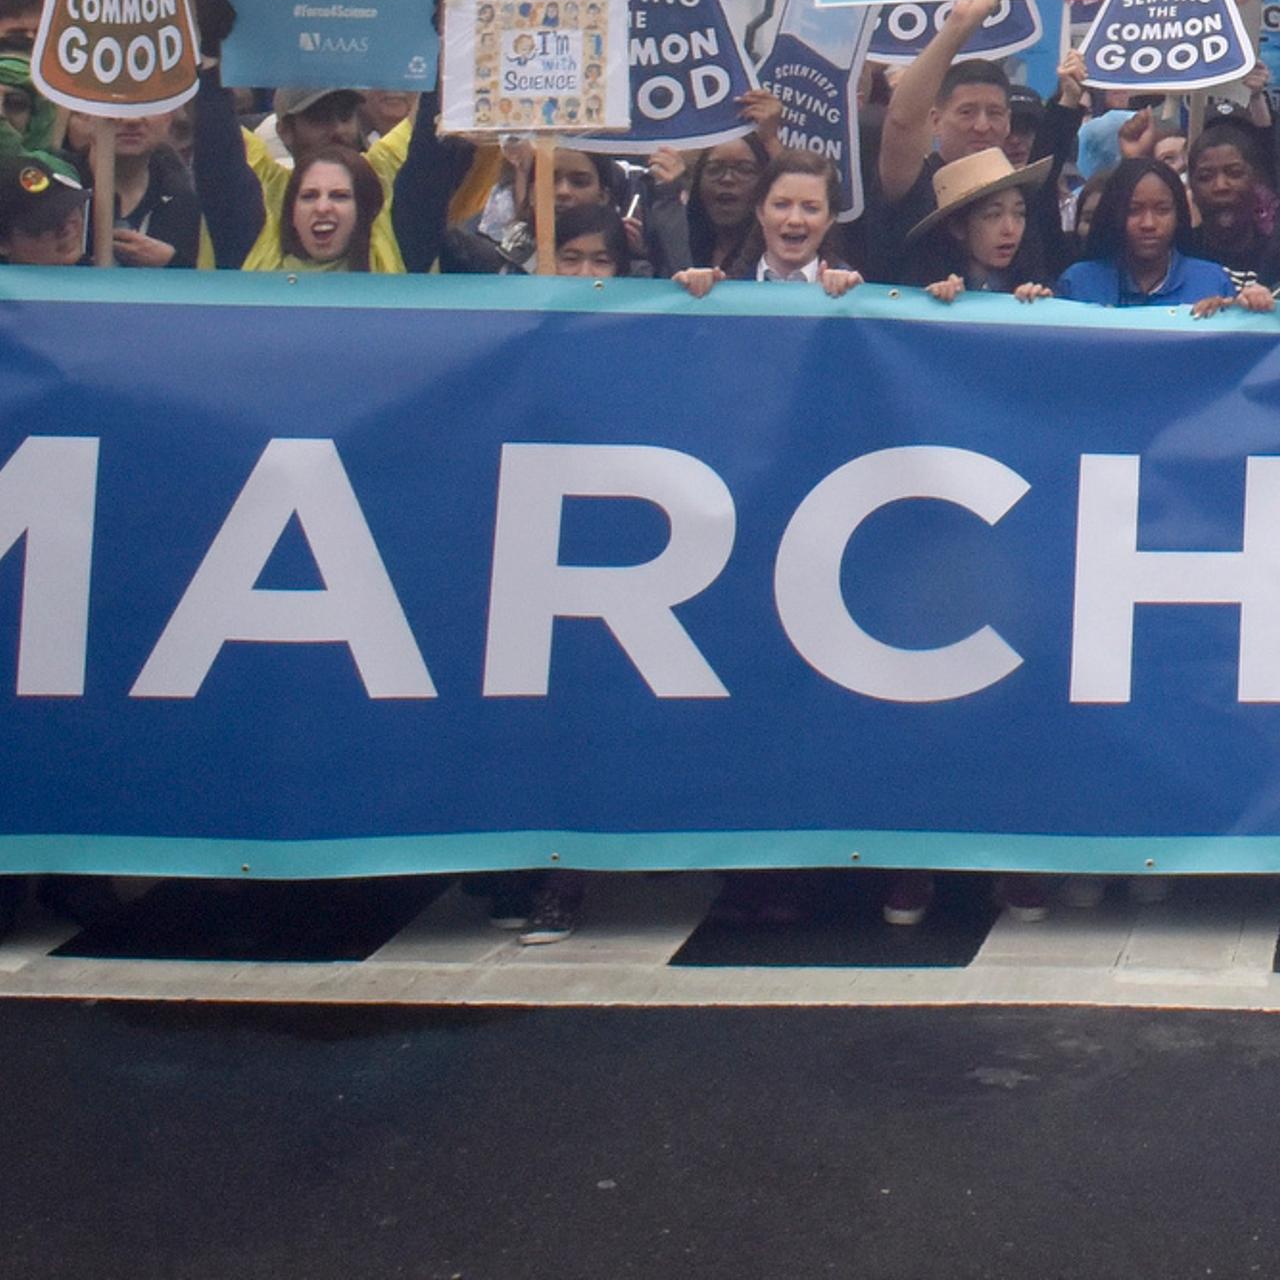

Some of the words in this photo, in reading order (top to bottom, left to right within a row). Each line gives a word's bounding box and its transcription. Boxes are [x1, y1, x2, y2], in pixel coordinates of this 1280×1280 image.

[1106, 13, 1223, 42] COMMON
[1147, 6, 1178, 17] THE
[57, 24, 183, 84] GOOD
[537, 30, 570, 55] I'm
[629, 27, 720, 67] MON
[1095, 34, 1229, 74] GOOD
[504, 70, 577, 91] SCIENCE
[637, 63, 732, 121] OD
[774, 63, 839, 99] SCIENTISTS
[762, 80, 842, 124] SERVING
[780, 106, 808, 127] THE
